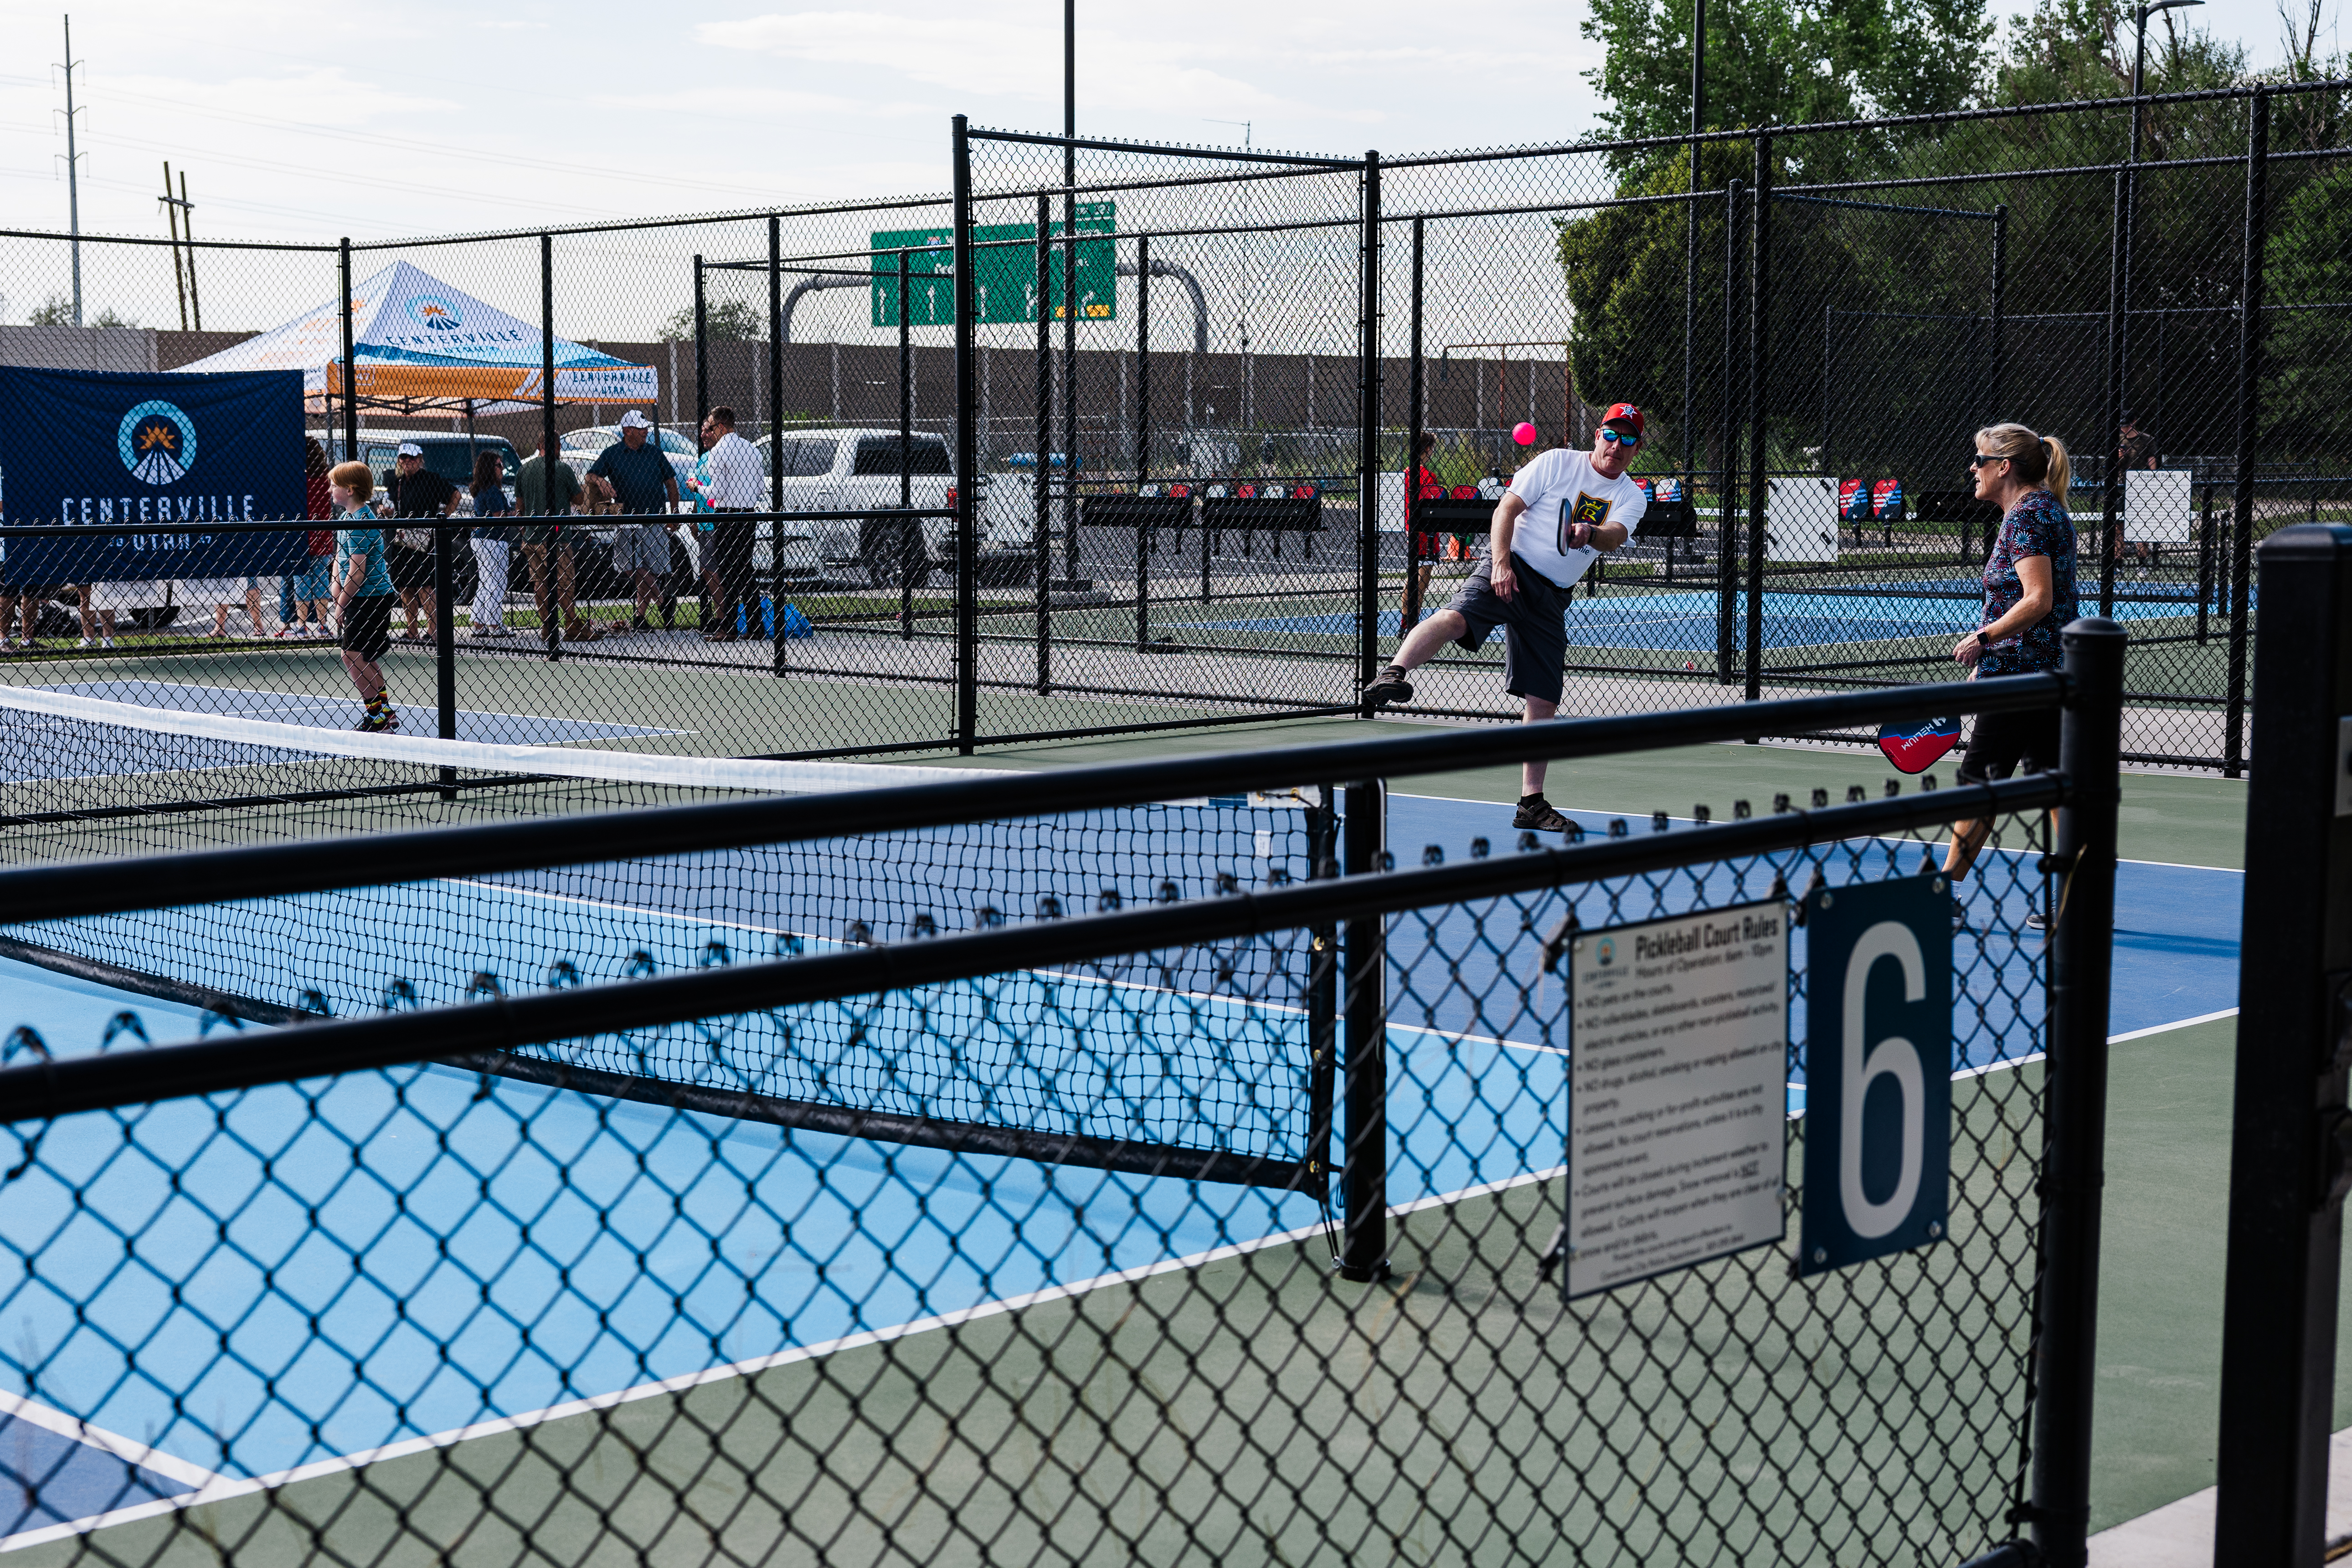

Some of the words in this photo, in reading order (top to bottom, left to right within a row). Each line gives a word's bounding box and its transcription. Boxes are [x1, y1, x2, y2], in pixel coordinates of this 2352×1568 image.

[386, 329, 523, 345] CENTERVILLE
[573, 371, 651, 384] CENTERVILLE
[62, 495, 254, 525] CENTERVILLE
[134, 534, 190, 551] UTAH
[1901, 723, 1934, 751] HELIUM
[1636, 927, 1700, 960] Pickleball
[1704, 918, 1740, 949] Court
[1743, 911, 1779, 941] Rules
[1635, 966, 1662, 979] Hours
[1666, 960, 1673, 974] of
[1585, 995, 1599, 1008] NO
[1622, 992, 1631, 1002] on
[1633, 987, 1646, 999] the
[1585, 1016, 1599, 1029] NO
[1584, 1059, 1599, 1072] NO
[1584, 1079, 1599, 1093] NO
[1841, 920, 1926, 1239] 6
[1740, 1162, 1760, 1177] NOT
